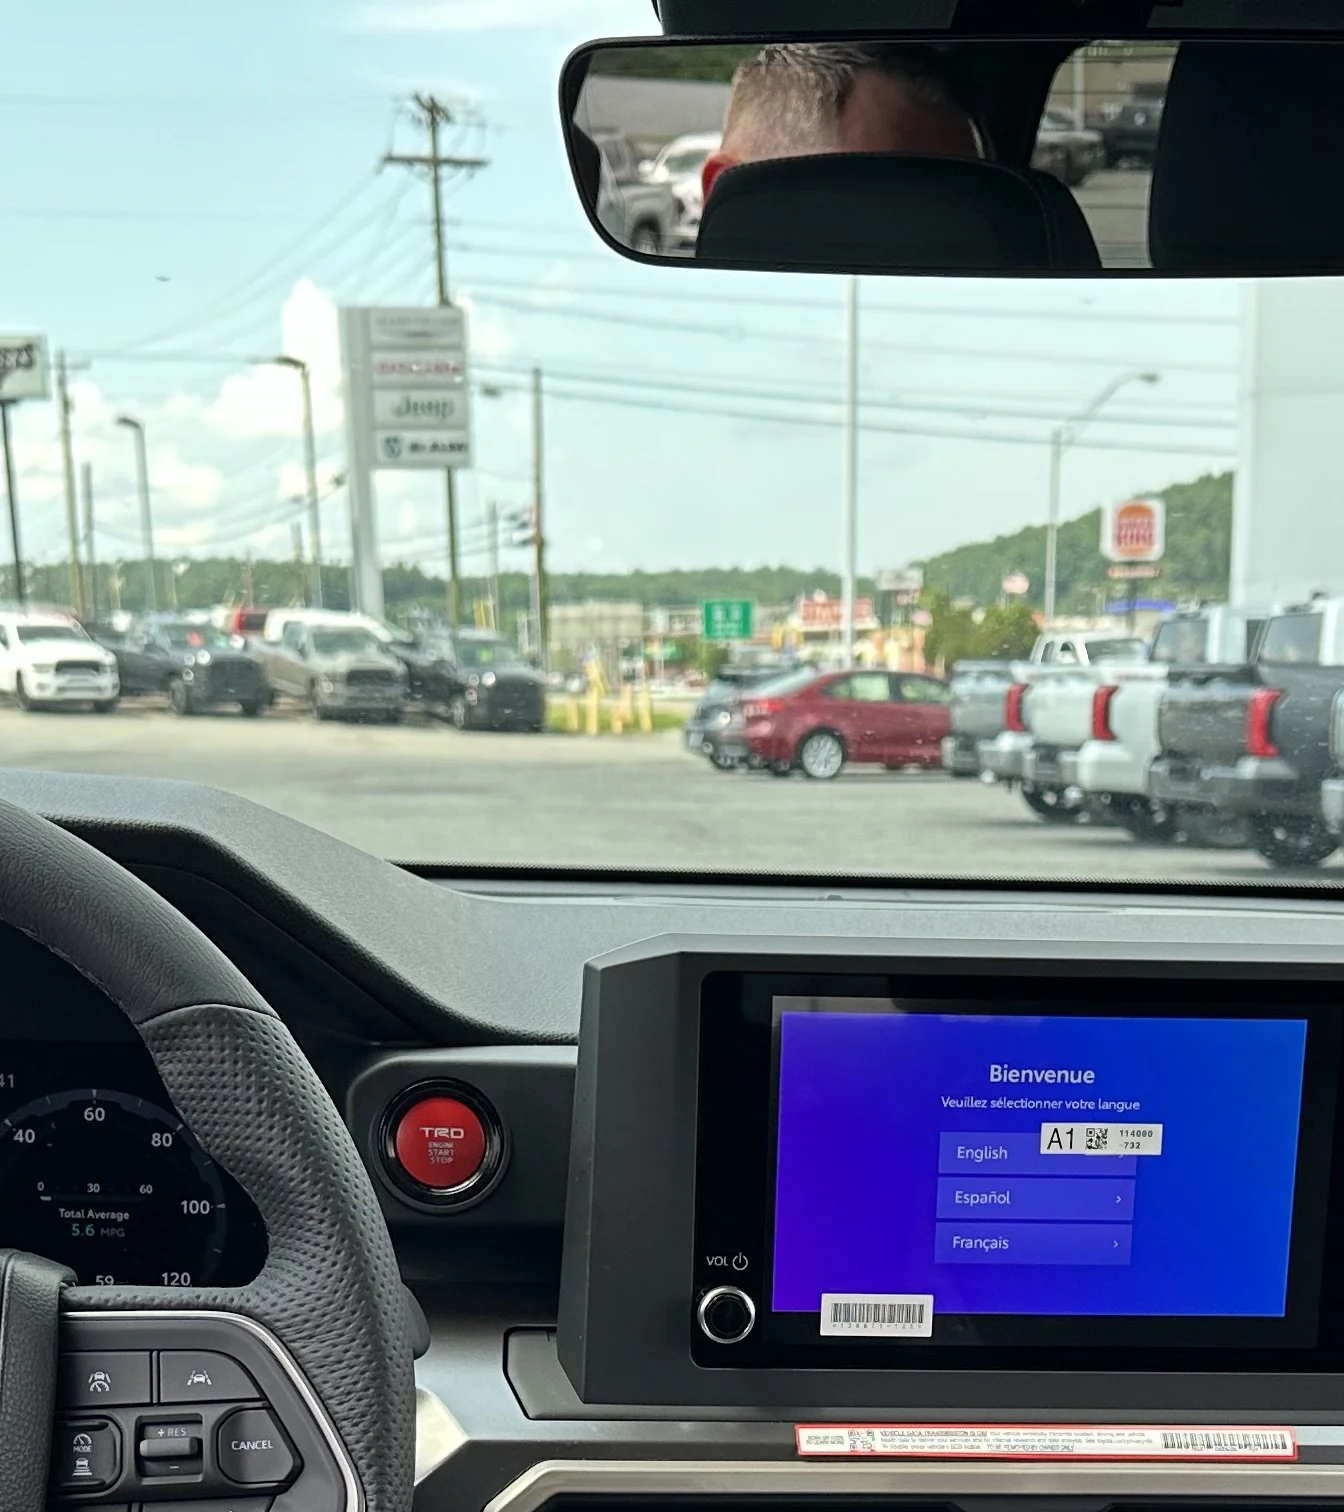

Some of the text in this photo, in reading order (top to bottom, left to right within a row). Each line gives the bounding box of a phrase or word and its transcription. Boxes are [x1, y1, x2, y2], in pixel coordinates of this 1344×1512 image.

[988, 1063, 1096, 1085] Bienvenue
[941, 1096, 1141, 1113] Veuillez sélectionner votre langue
[84, 1107, 106, 1122] 60
[13, 1129, 36, 1144] 40
[151, 1132, 173, 1148] 80
[420, 1127, 465, 1139] TRD
[1046, 1127, 1075, 1150] A1
[430, 1157, 454, 1165] STOP
[956, 1146, 1008, 1162] English
[37, 1182, 45, 1191] 0
[87, 1183, 100, 1193] 30
[139, 1184, 153, 1195] 60
[954, 1190, 1011, 1206] Español
[59, 1209, 130, 1221] Total Average
[180, 1200, 210, 1215] 100
[71, 1224, 125, 1238] 5.6 MPG
[952, 1235, 1009, 1253] Français
[706, 1255, 728, 1267] VOL
[161, 1272, 191, 1287] 120
[167, 1427, 187, 1437] RES
[231, 1440, 274, 1450] CANCEL
